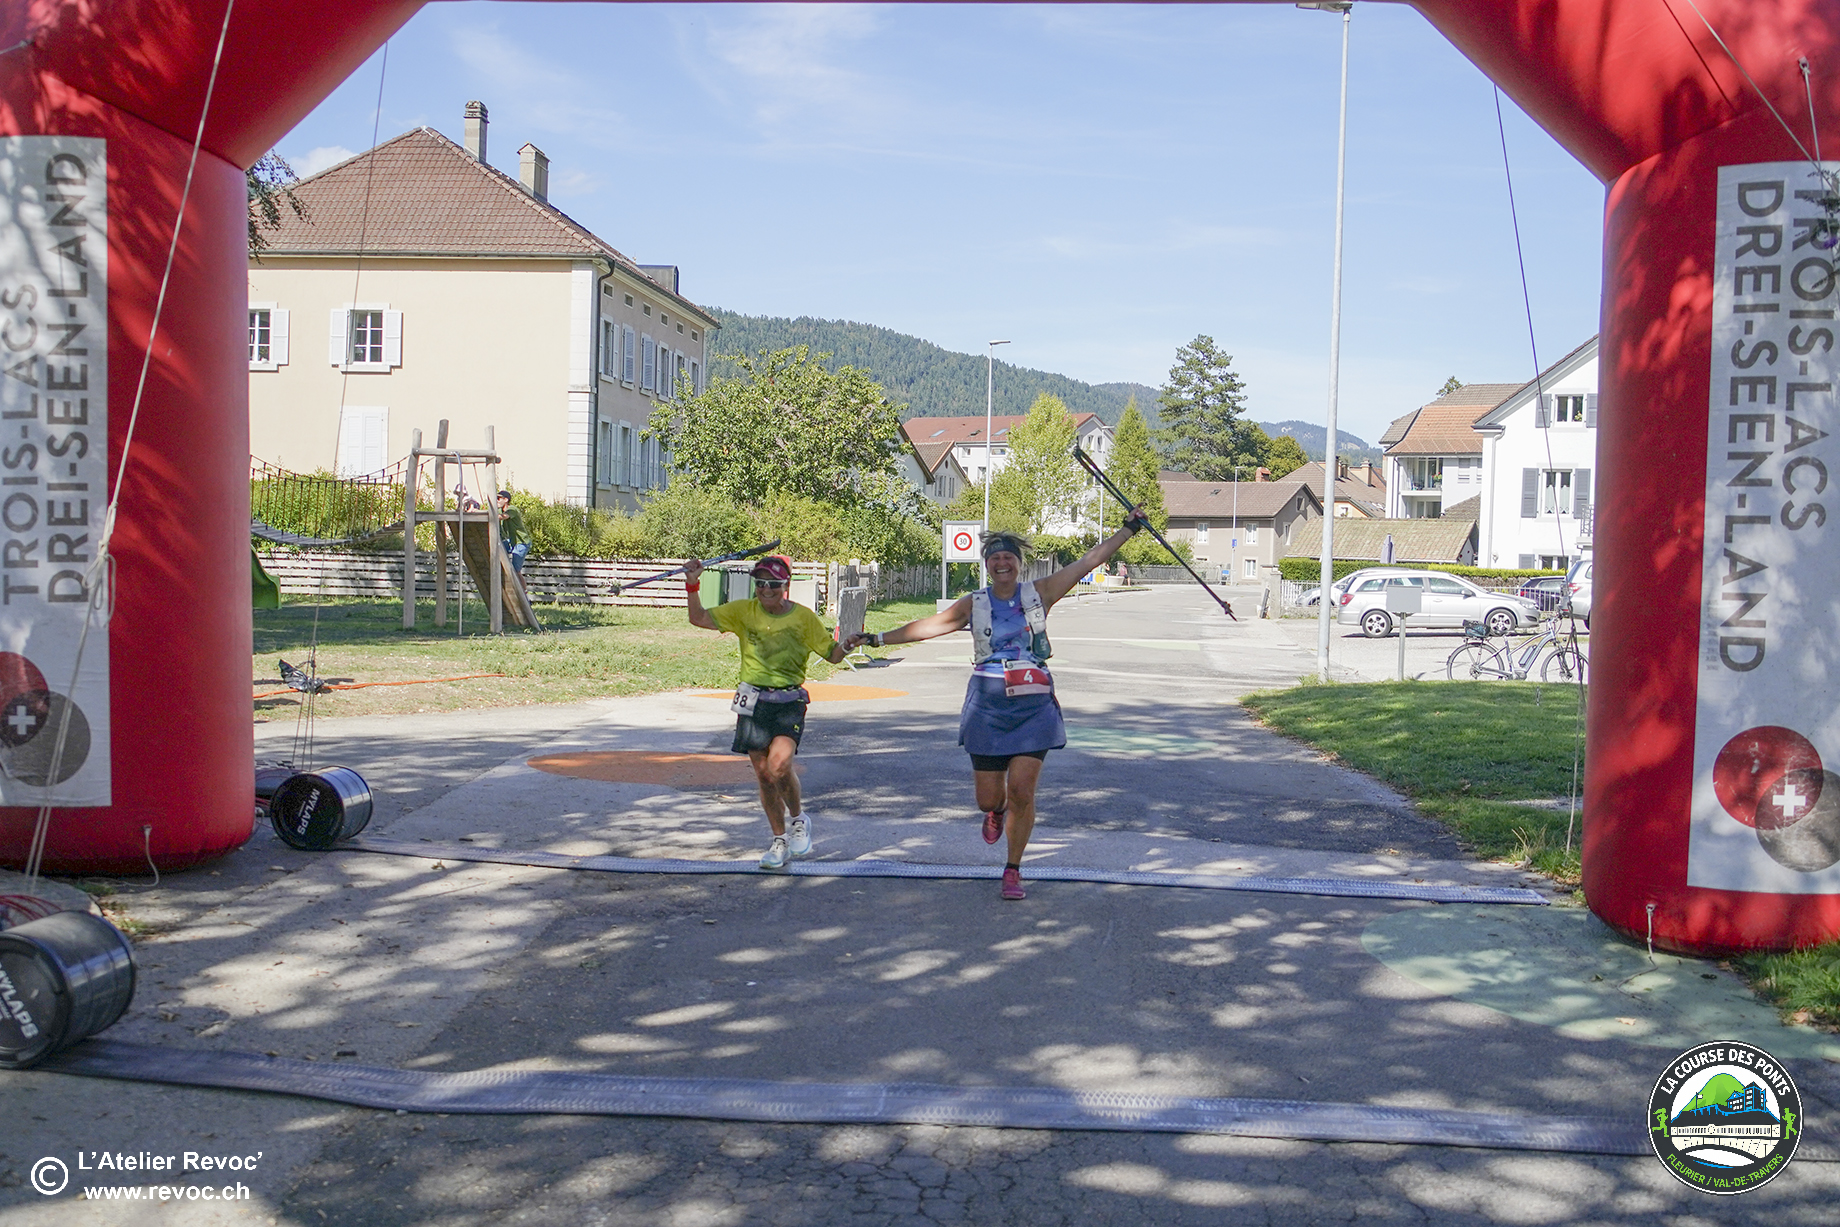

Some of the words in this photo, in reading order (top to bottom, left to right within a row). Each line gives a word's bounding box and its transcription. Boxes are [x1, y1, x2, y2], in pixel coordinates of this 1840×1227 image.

[2, 284, 39, 605] TROIS-LACS
[46, 153, 89, 603] DREI-SEEN-LAND
[1719, 180, 1785, 673] DREI-SEEN-LAND
[959, 537, 968, 546] 30
[1023, 669, 1034, 683] 4
[297, 788, 320, 835] MYLAPS
